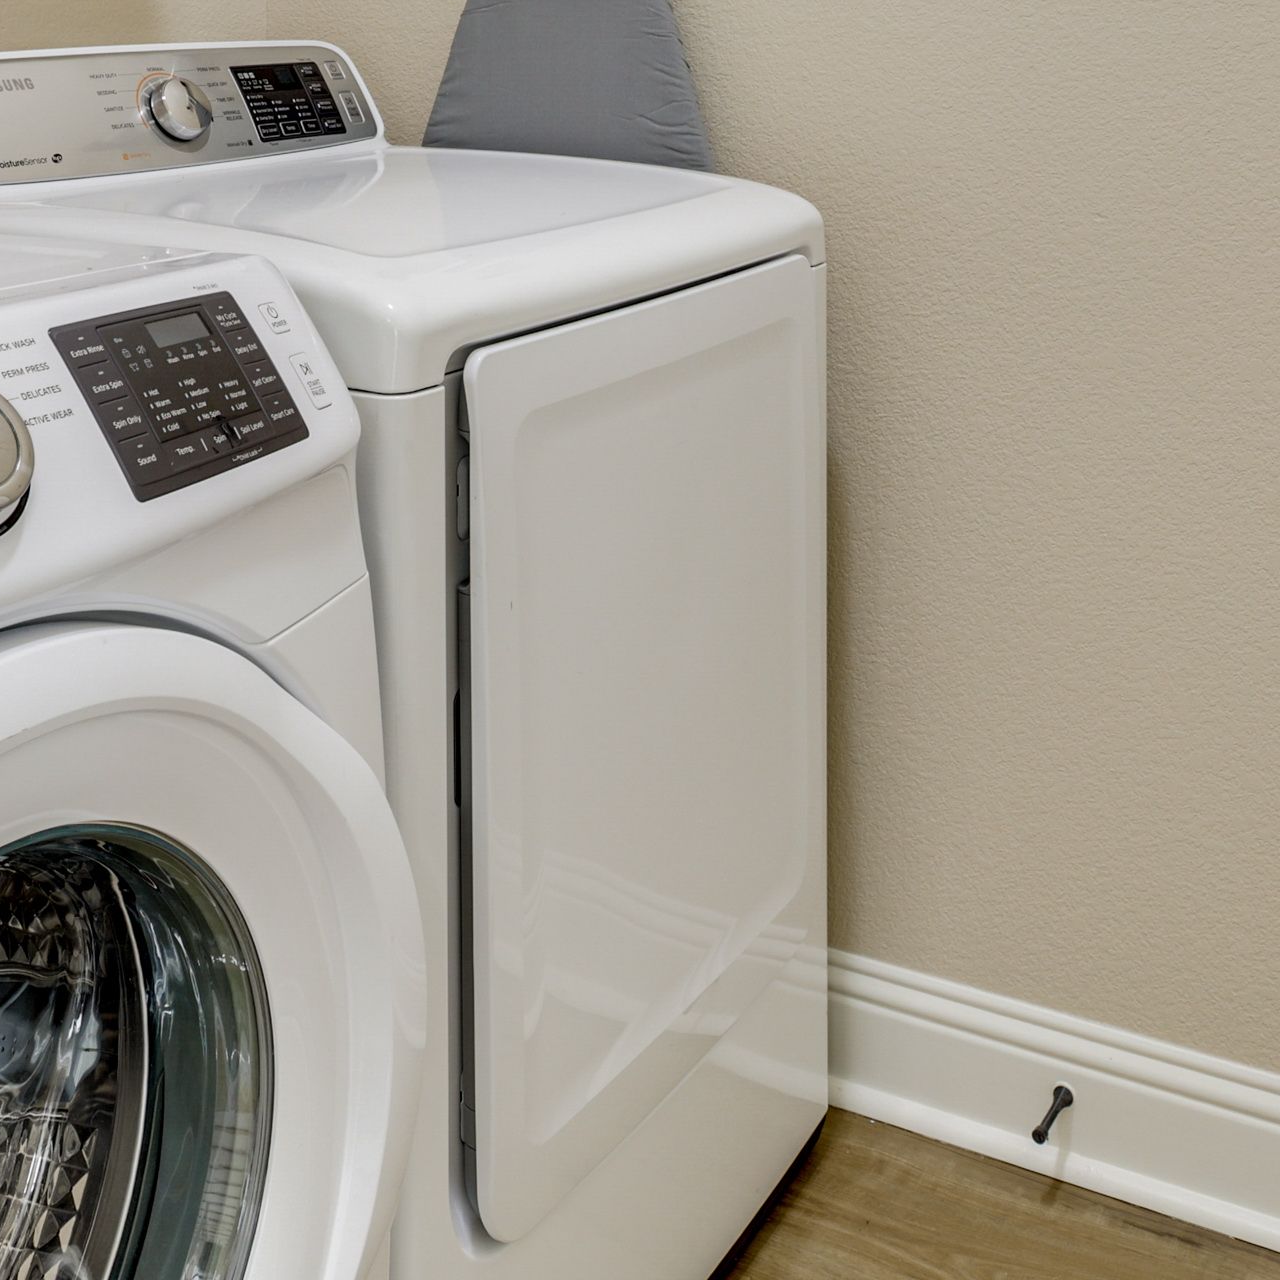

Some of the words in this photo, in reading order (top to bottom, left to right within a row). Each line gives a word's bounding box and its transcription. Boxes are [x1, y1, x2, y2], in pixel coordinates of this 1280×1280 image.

[215, 314, 226, 322] My
[225, 311, 238, 320] Cycle
[271, 319, 288, 328] POWER
[11, 337, 37, 349] WASH
[70, 348, 88, 359] Extra
[87, 344, 105, 354] Rinse
[235, 345, 248, 356] Delay
[247, 342, 258, 352] End
[1, 368, 25, 379] PERM
[25, 362, 50, 374] PRESS
[92, 384, 109, 394] Extra
[109, 379, 124, 391] Spin
[183, 377, 197, 387] High
[223, 379, 239, 388] Heavy
[252, 378, 263, 388] Self
[20, 384, 62, 401] DELICATES
[148, 388, 160, 397] Hot
[189, 387, 210, 397] Medium
[229, 389, 247, 399] Normal
[154, 399, 172, 408] Warm
[195, 401, 208, 409] Low
[235, 401, 249, 411] Light
[24, 414, 51, 426] ACTIVE
[50, 408, 74, 420] WEAR
[161, 411, 172, 420] Eco
[171, 407, 187, 417] Warm
[201, 412, 210, 420] No
[209, 409, 222, 418] Spin
[270, 410, 283, 421] Smart
[282, 407, 295, 417] Care
[112, 419, 127, 430] Spin
[127, 414, 142, 426] Only
[166, 422, 180, 432] Cold
[240, 424, 251, 435] Soil
[250, 420, 265, 431] Level
[213, 434, 228, 444] Spin
[137, 453, 158, 466] Sound
